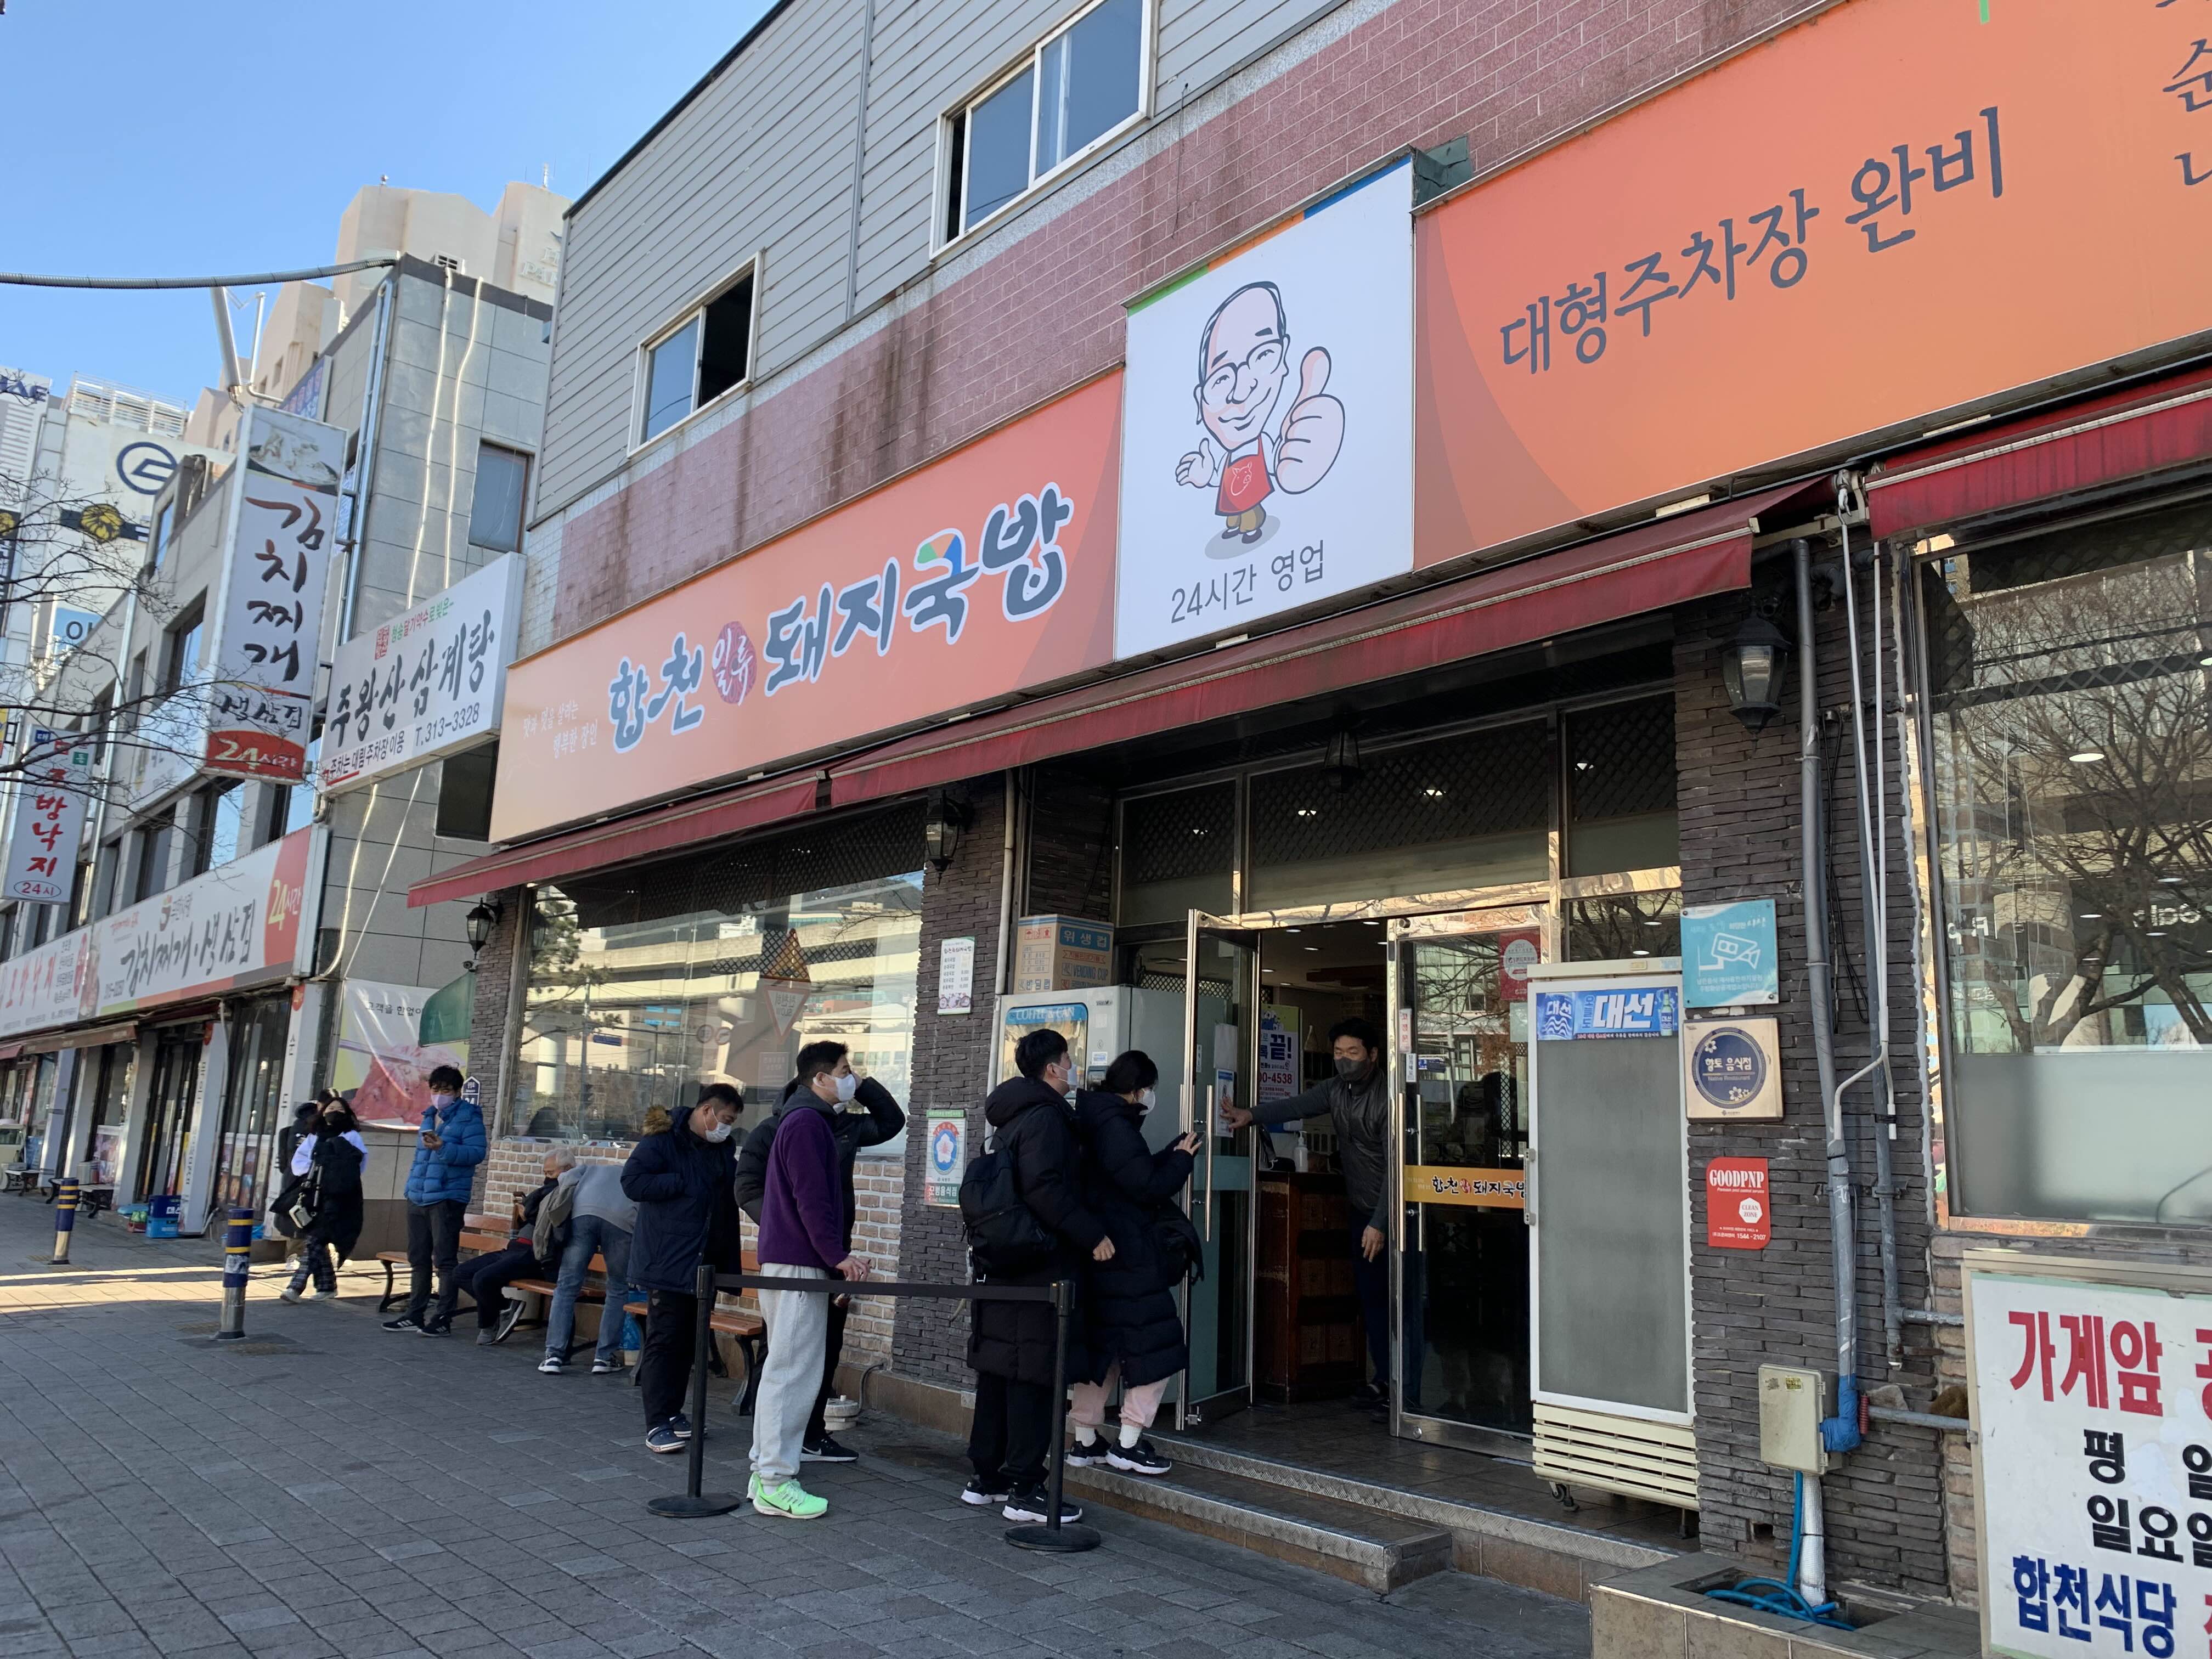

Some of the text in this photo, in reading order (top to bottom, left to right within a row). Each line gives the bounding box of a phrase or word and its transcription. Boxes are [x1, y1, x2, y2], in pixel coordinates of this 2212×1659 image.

[1499, 105, 2004, 374] 대형주차장 완비
[245, 496, 325, 682] 김치찌개
[1171, 540, 1324, 624] 24시간 영업
[608, 631, 705, 753] 합천
[764, 482, 1074, 696] 돼지국밥
[330, 609, 494, 748] 주왕산삼계탕
[1017, 1008, 1045, 1020] COFFEE
[1546, 1000, 1572, 1019] 대선
[1592, 992, 1655, 1029] 대선
[1269, 1034, 1292, 1060] 끝!
[1705, 1057, 1752, 1072] 향토 음식점
[1431, 1175, 1459, 1194] 합천
[1709, 1169, 1765, 1188] GOODPNP
[2008, 1310, 2163, 1417] 가게앞
[2012, 1554, 2177, 1658] 합천식당
